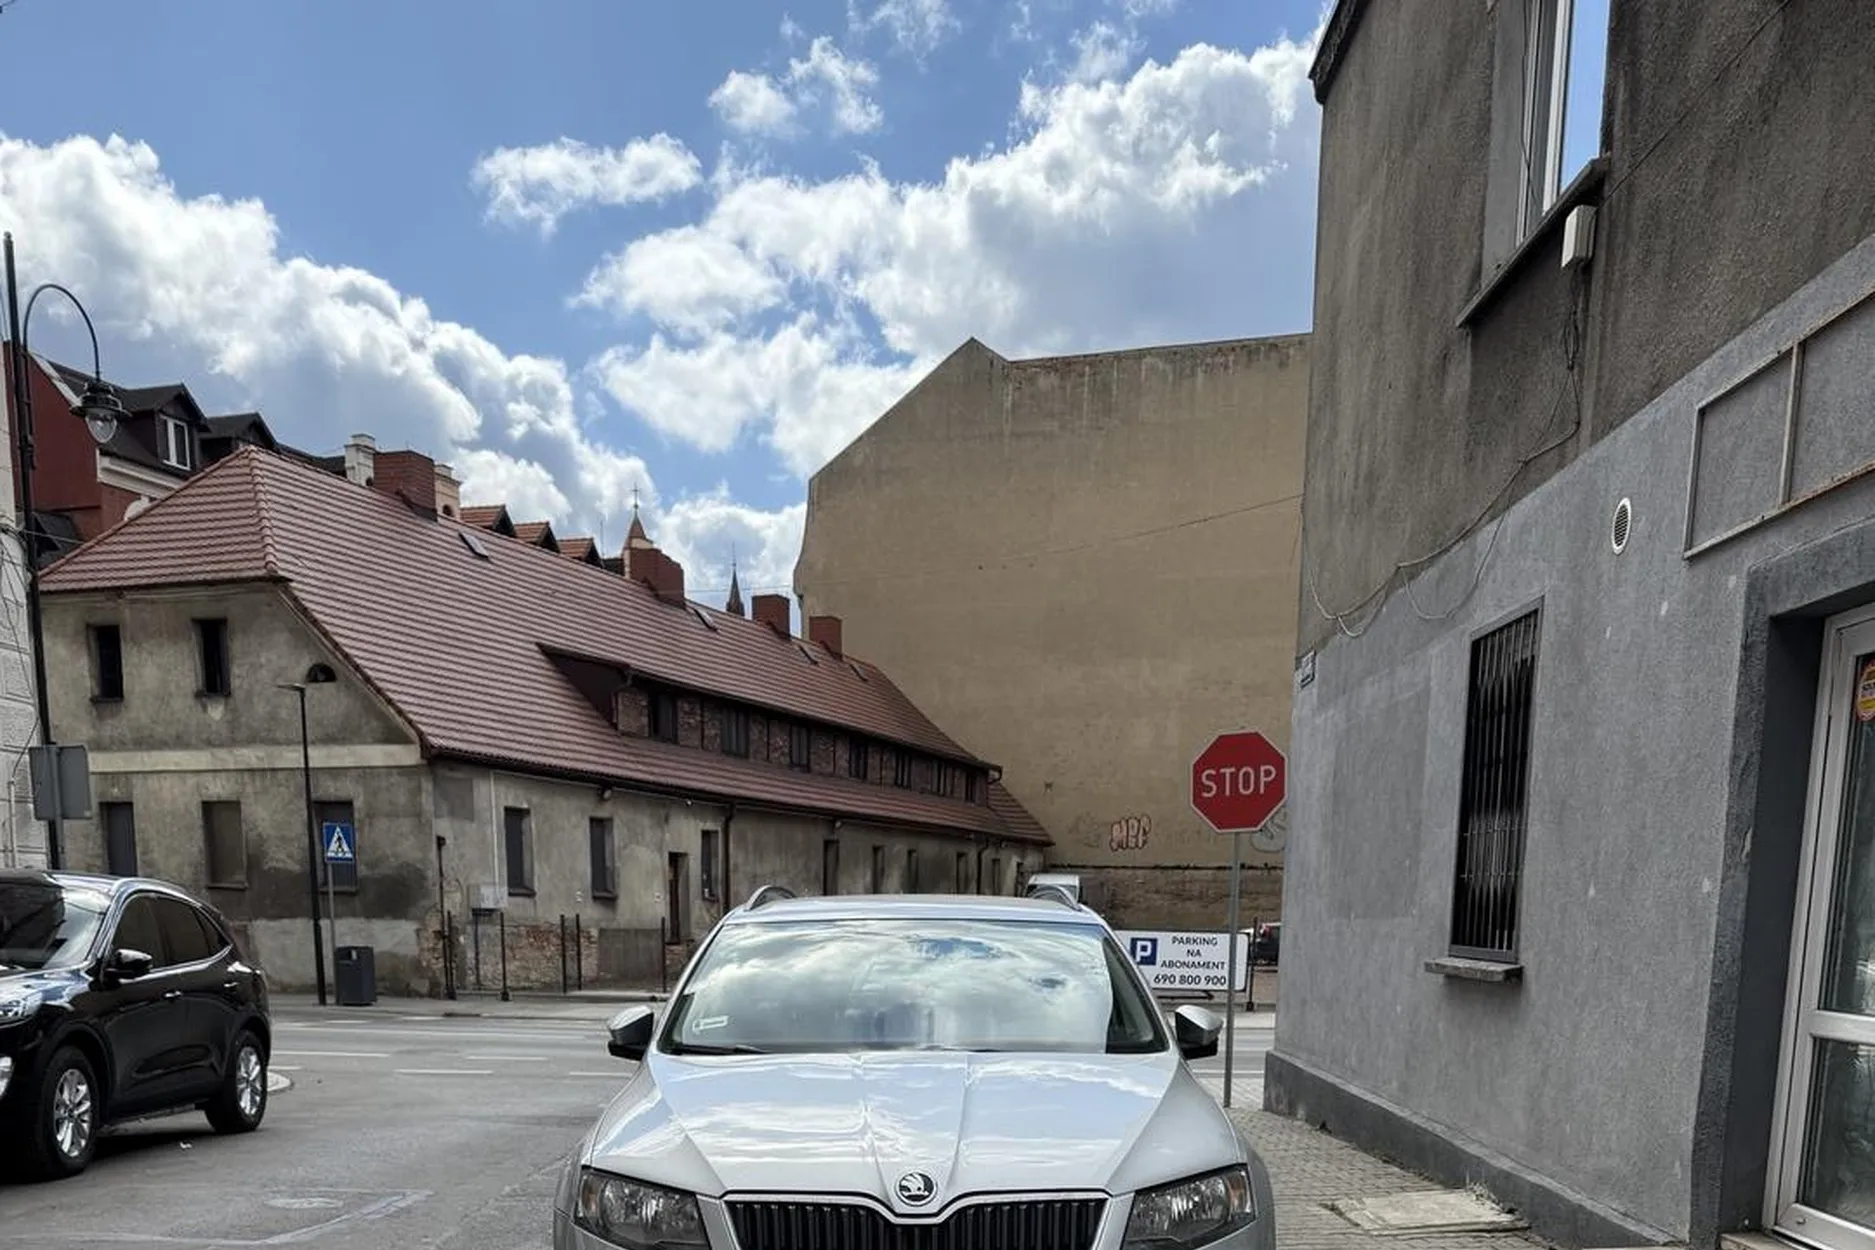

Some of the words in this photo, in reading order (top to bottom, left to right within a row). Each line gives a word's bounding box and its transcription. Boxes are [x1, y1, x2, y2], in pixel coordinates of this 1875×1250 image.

[1201, 764, 1277, 798] STOP
[1171, 936, 1218, 946] PARKING
[1186, 949, 1202, 957] NA
[1160, 960, 1226, 970] ABONAMENT
[1153, 974, 1176, 985] 690
[1179, 975, 1202, 985] 800
[1204, 975, 1227, 986] 900
